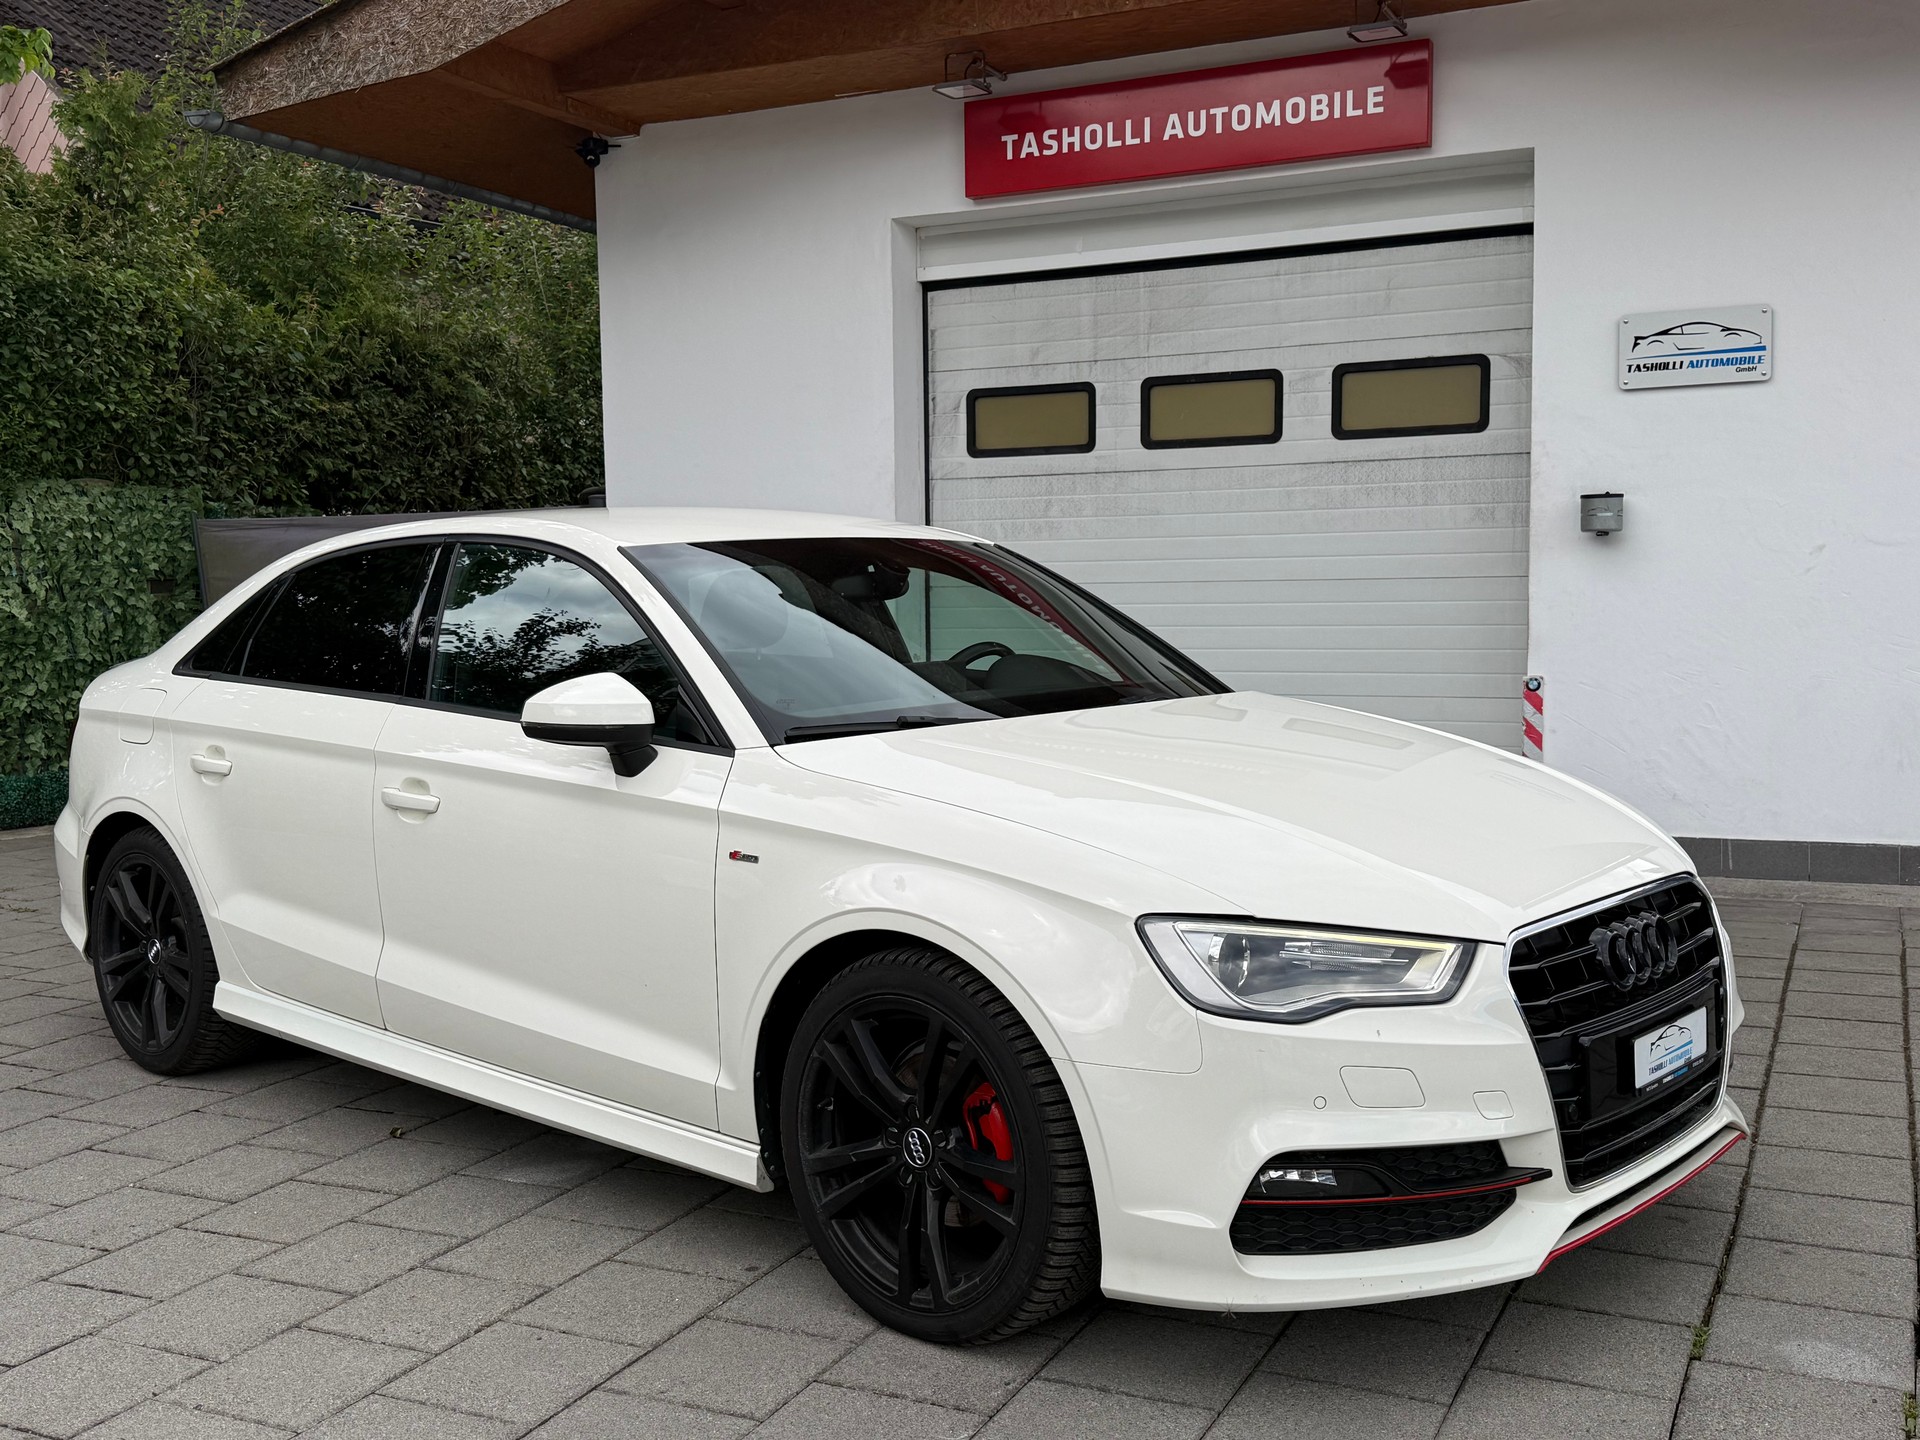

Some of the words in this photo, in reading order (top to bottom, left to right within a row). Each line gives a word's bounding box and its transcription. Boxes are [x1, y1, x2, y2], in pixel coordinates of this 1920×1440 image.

[1001, 116, 1151, 160] TASHOLLI
[1163, 85, 1385, 141] AUTOMOBILE
[1626, 360, 1684, 373] TASHOLLI
[1686, 355, 1766, 369] AUTOMOBILE
[1735, 365, 1758, 373] GmbH
